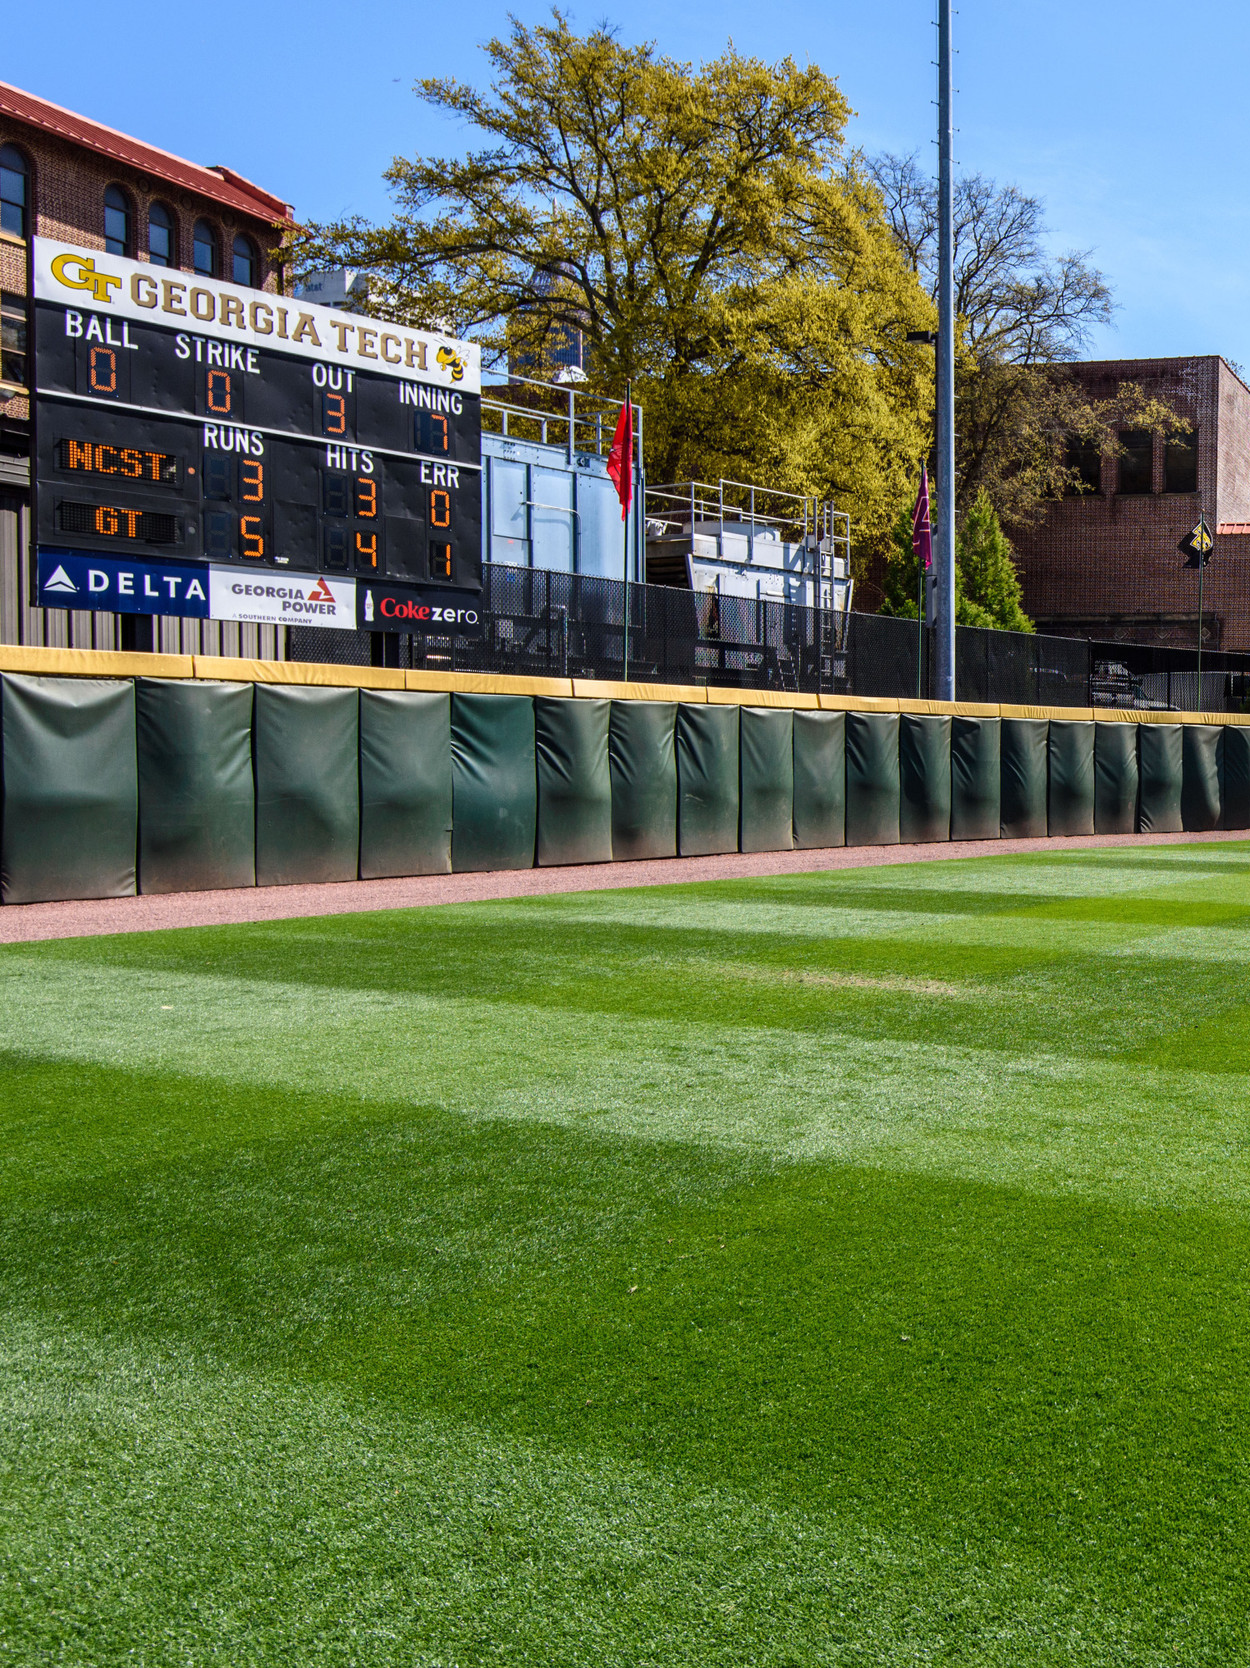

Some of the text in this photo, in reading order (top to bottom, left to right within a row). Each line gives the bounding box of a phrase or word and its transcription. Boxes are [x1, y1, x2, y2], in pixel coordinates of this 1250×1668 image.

[51, 253, 122, 303] GT
[65, 309, 139, 350] BALL
[131, 273, 429, 371] GEORGIA TECH
[90, 346, 116, 392] 0
[175, 333, 261, 374] STRIKE
[207, 370, 232, 414] 0
[312, 362, 356, 393] OUT
[327, 393, 346, 435] 3
[400, 380, 463, 415] INNING
[204, 423, 264, 456] RUNS
[431, 414, 448, 450] 7
[69, 440, 167, 480] NCST
[326, 444, 374, 474] HITS
[420, 460, 460, 489] ERR
[243, 459, 263, 502] 3
[358, 477, 377, 518] 3
[95, 506, 143, 538] GT
[430, 489, 450, 528] 0
[241, 515, 264, 558] 5
[356, 532, 377, 568] 4
[445, 544, 451, 576] 1
[88, 569, 206, 601] DELTA
[231, 583, 305, 600] GEORGIA
[238, 613, 277, 622] SOUTHERN
[278, 616, 313, 624] COMPANY
[282, 601, 337, 616] POWER
[380, 597, 479, 625] Coke zero
